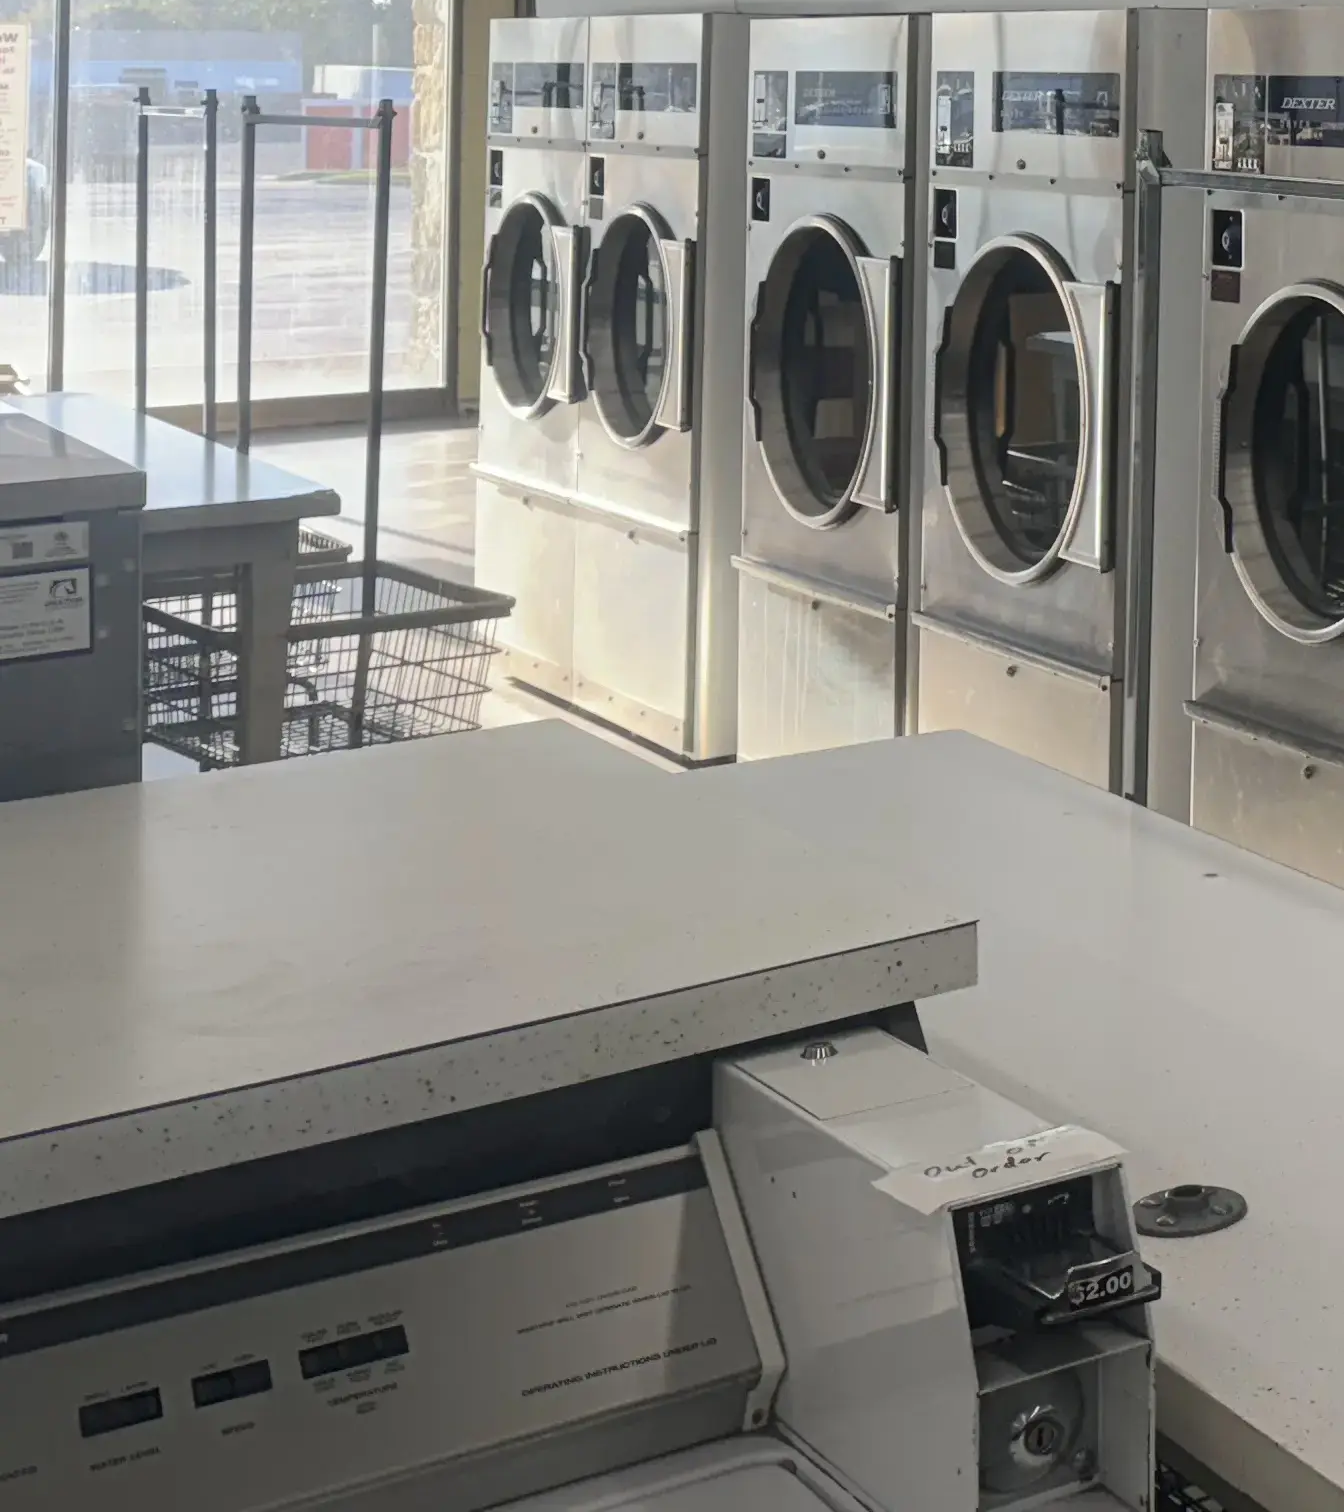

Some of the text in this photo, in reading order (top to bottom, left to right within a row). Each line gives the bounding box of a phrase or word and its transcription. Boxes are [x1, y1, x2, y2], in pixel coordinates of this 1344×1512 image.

[1280, 97, 1337, 110] DEXTER
[924, 1155, 977, 1178] Out
[522, 1375, 584, 1397] OPERATING
[584, 1353, 661, 1380] INSTRUCTIONS
[663, 1341, 699, 1359] UNDER
